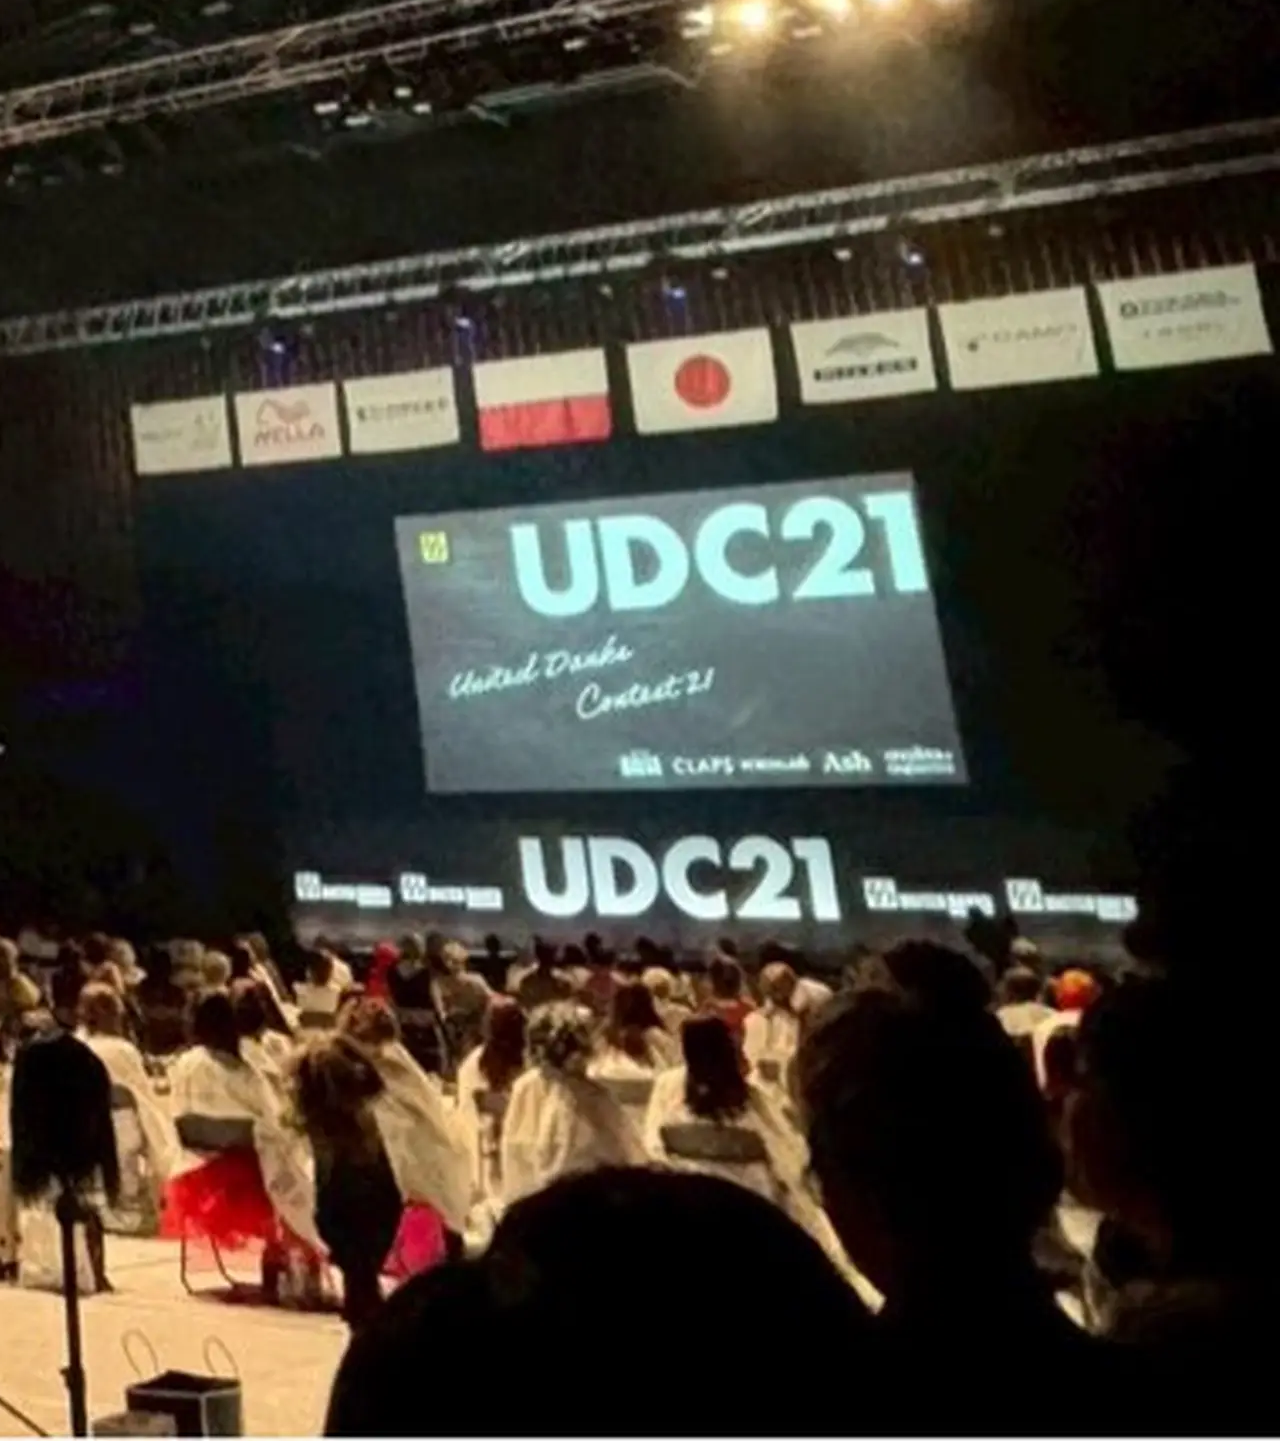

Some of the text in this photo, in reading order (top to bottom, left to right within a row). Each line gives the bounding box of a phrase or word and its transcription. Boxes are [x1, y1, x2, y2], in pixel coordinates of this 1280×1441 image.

[509, 490, 929, 618] UDC21
[448, 650, 539, 700] United
[575, 673, 682, 721] Contest
[671, 752, 735, 777] CLAPS
[822, 748, 874, 776] Ash
[518, 836, 842, 923] UDC21
